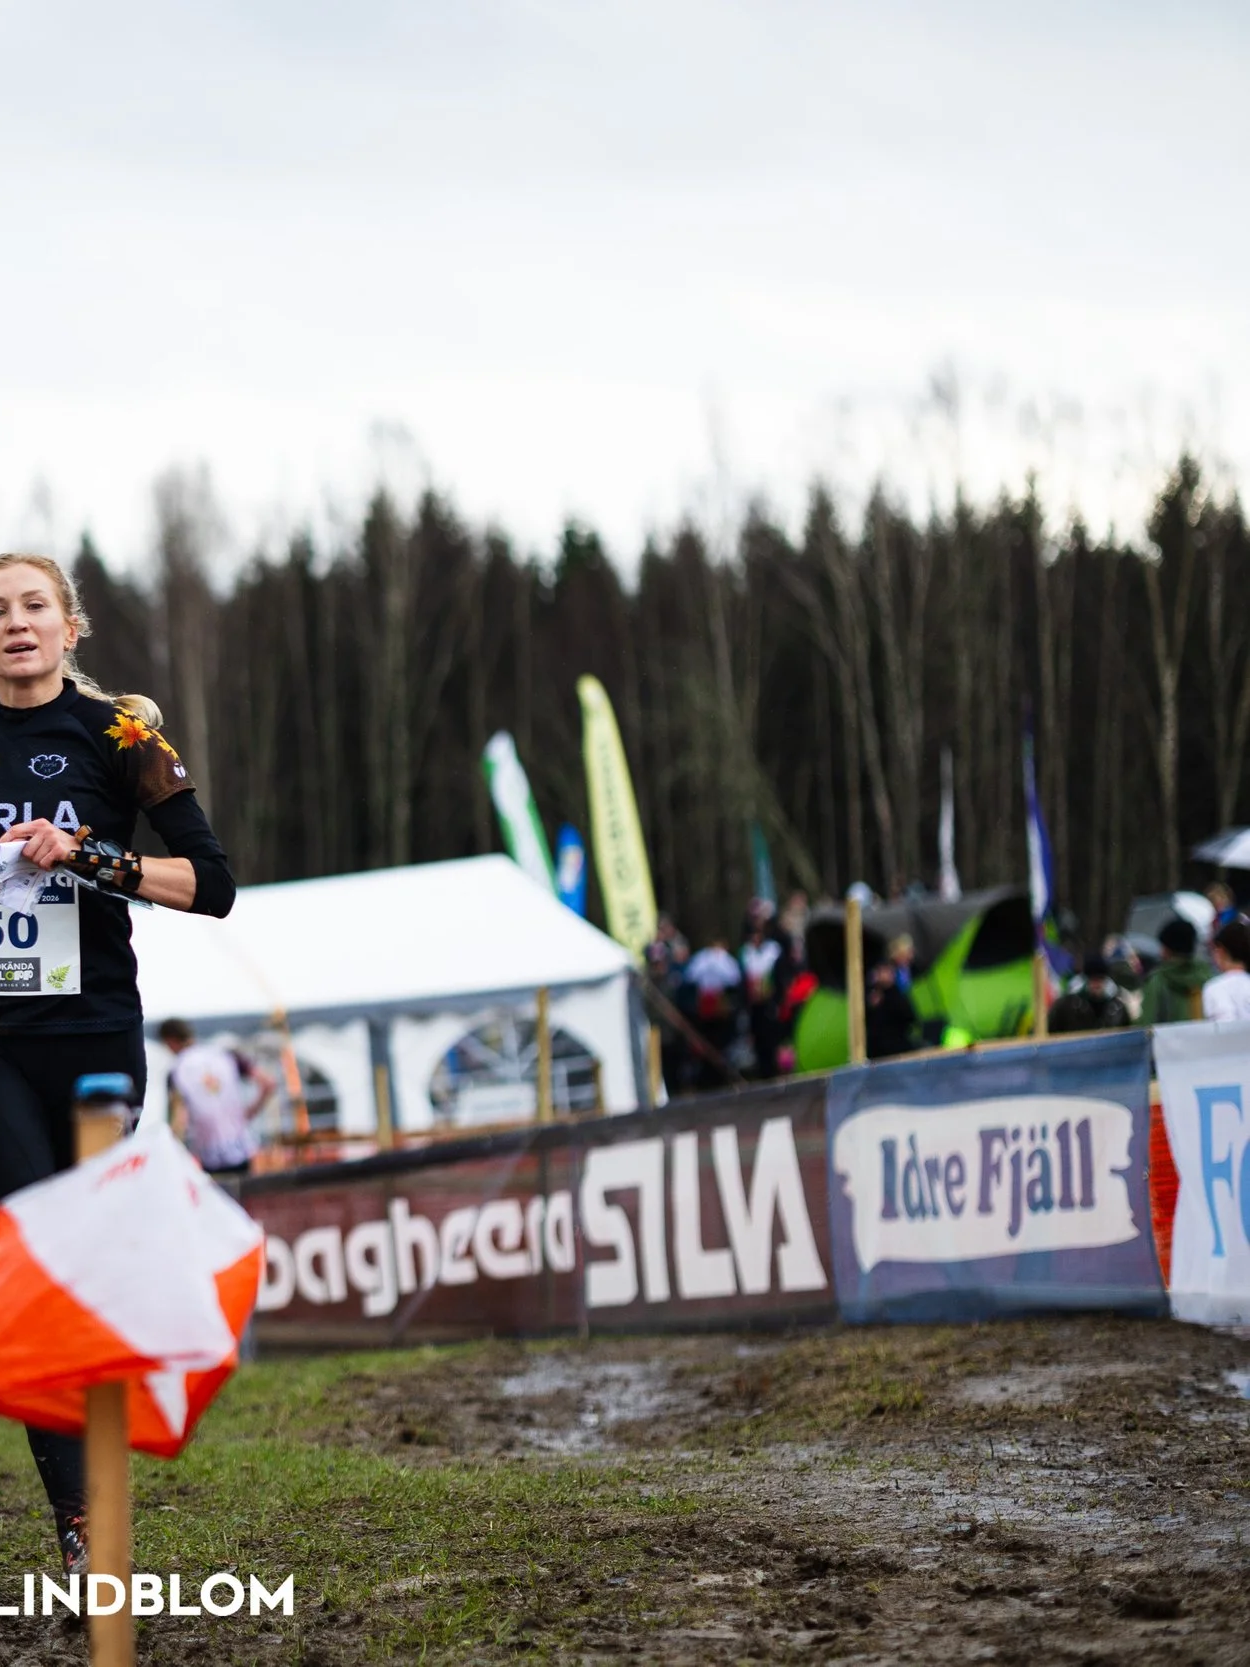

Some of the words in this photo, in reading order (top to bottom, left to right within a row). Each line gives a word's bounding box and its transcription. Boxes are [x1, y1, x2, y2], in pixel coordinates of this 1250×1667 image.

[580, 1116, 827, 1309] SILVA
[880, 1133, 967, 1222] Idre
[978, 1117, 1096, 1238] Fjäll
[1193, 1083, 1250, 1258] F
